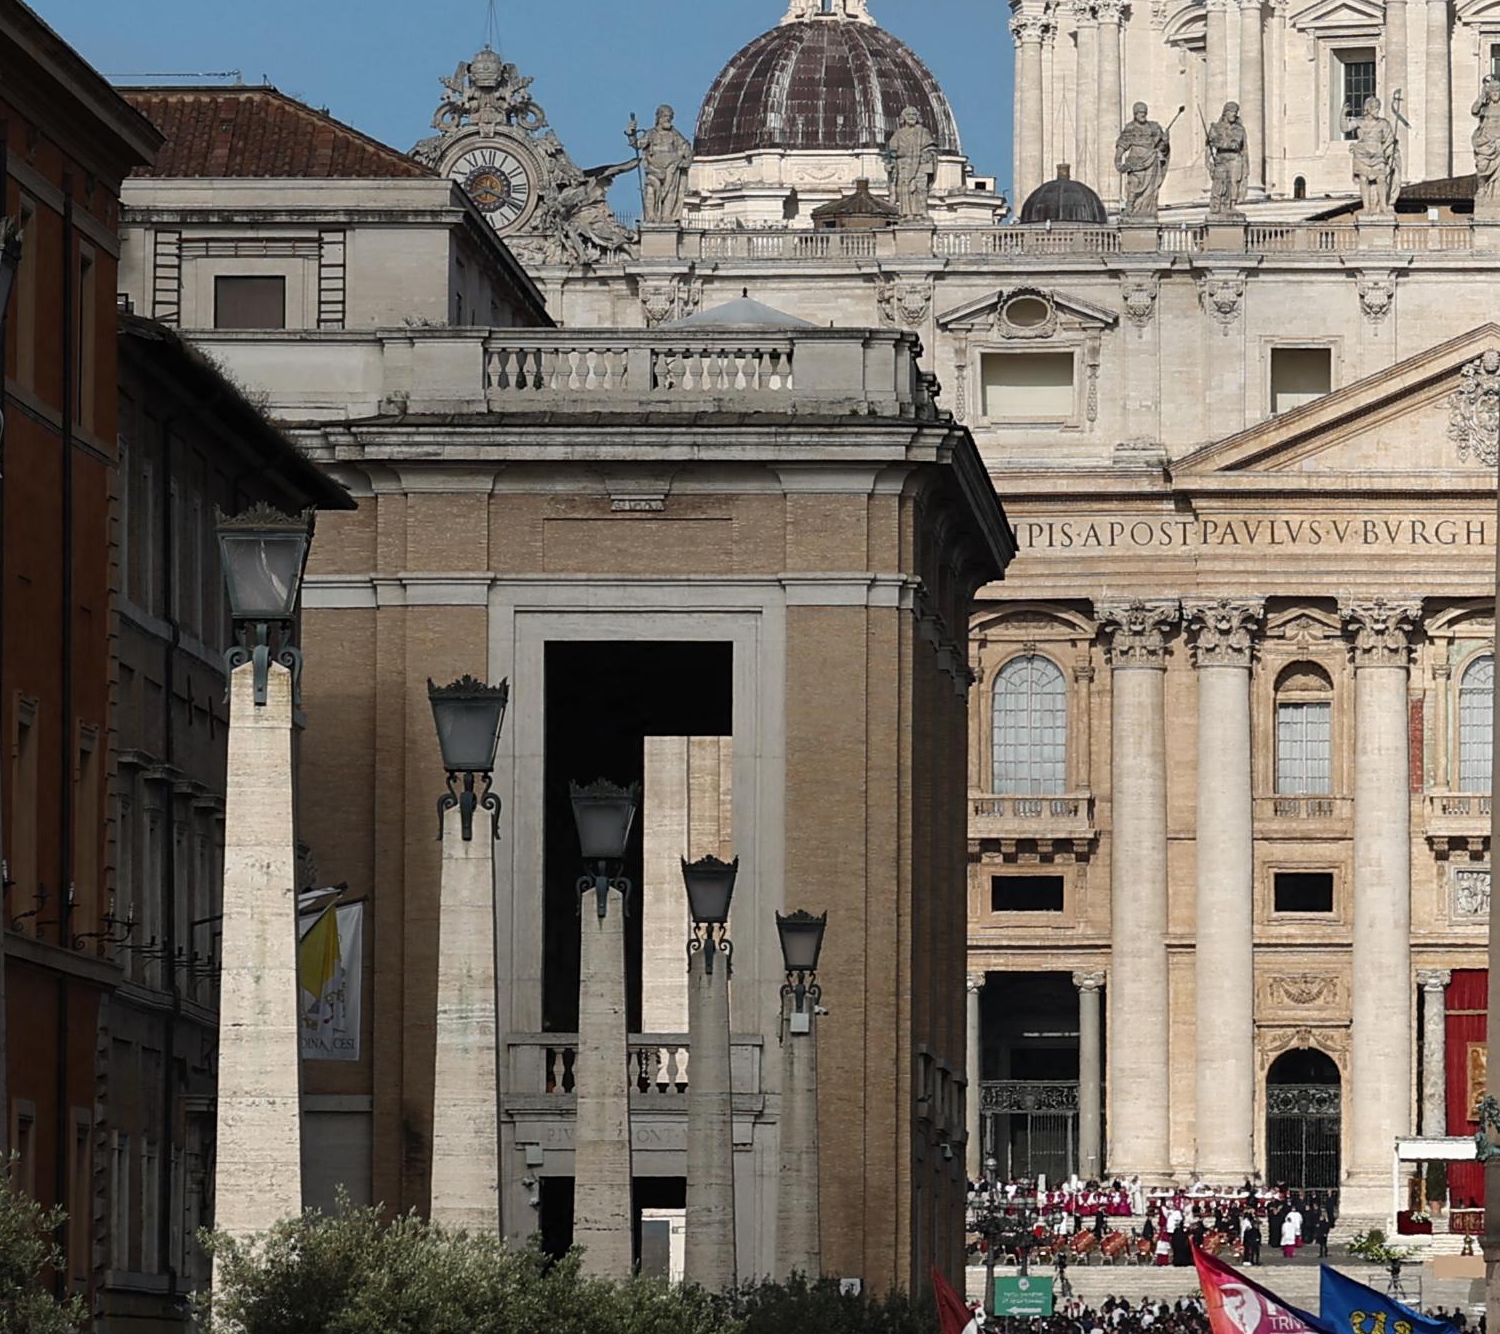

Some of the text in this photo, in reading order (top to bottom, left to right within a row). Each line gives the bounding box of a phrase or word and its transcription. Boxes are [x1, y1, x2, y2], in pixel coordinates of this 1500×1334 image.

[1080, 518, 1195, 544] APOST
[1201, 517, 1322, 543] PAVLVS
[1334, 517, 1351, 543] V
